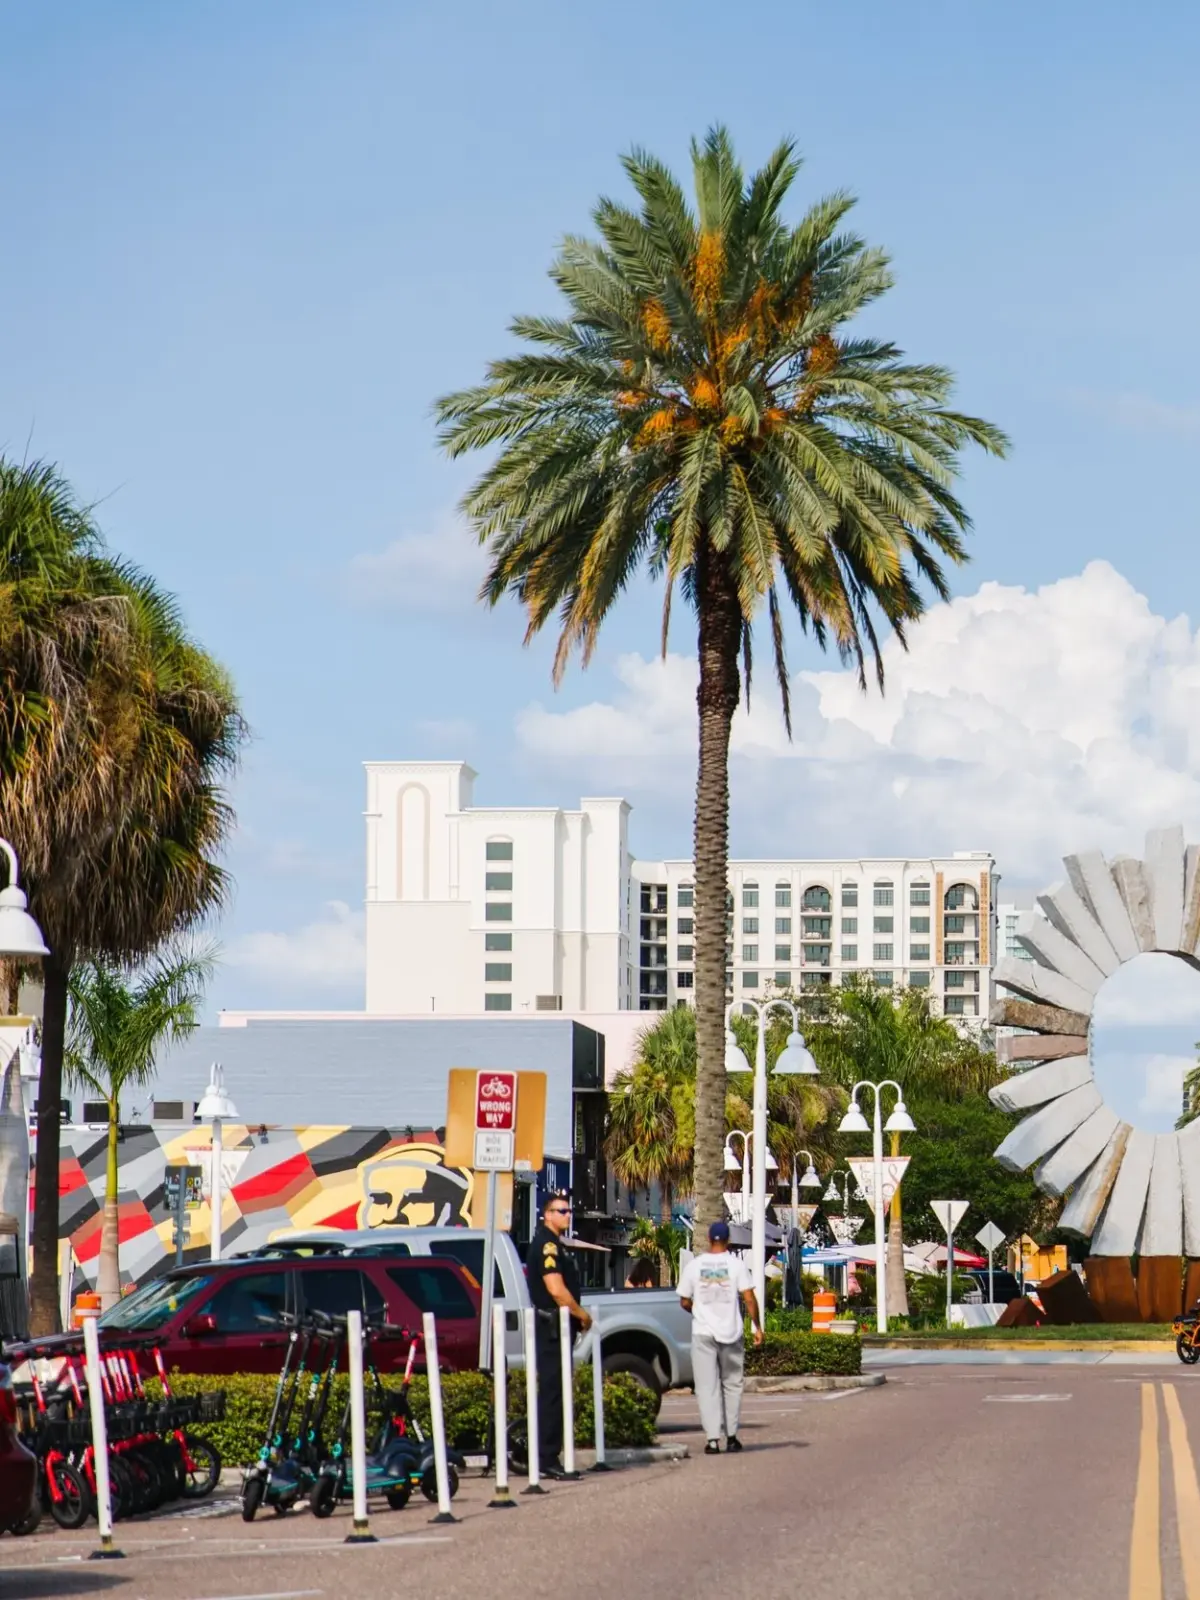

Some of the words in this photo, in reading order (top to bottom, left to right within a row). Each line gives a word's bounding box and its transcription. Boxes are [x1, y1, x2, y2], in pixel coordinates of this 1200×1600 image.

[479, 1101, 511, 1113] WRONG
[486, 1113, 504, 1123] WAY
[485, 1136, 501, 1144] RIDE
[479, 1156, 507, 1164] TRAFFIC
